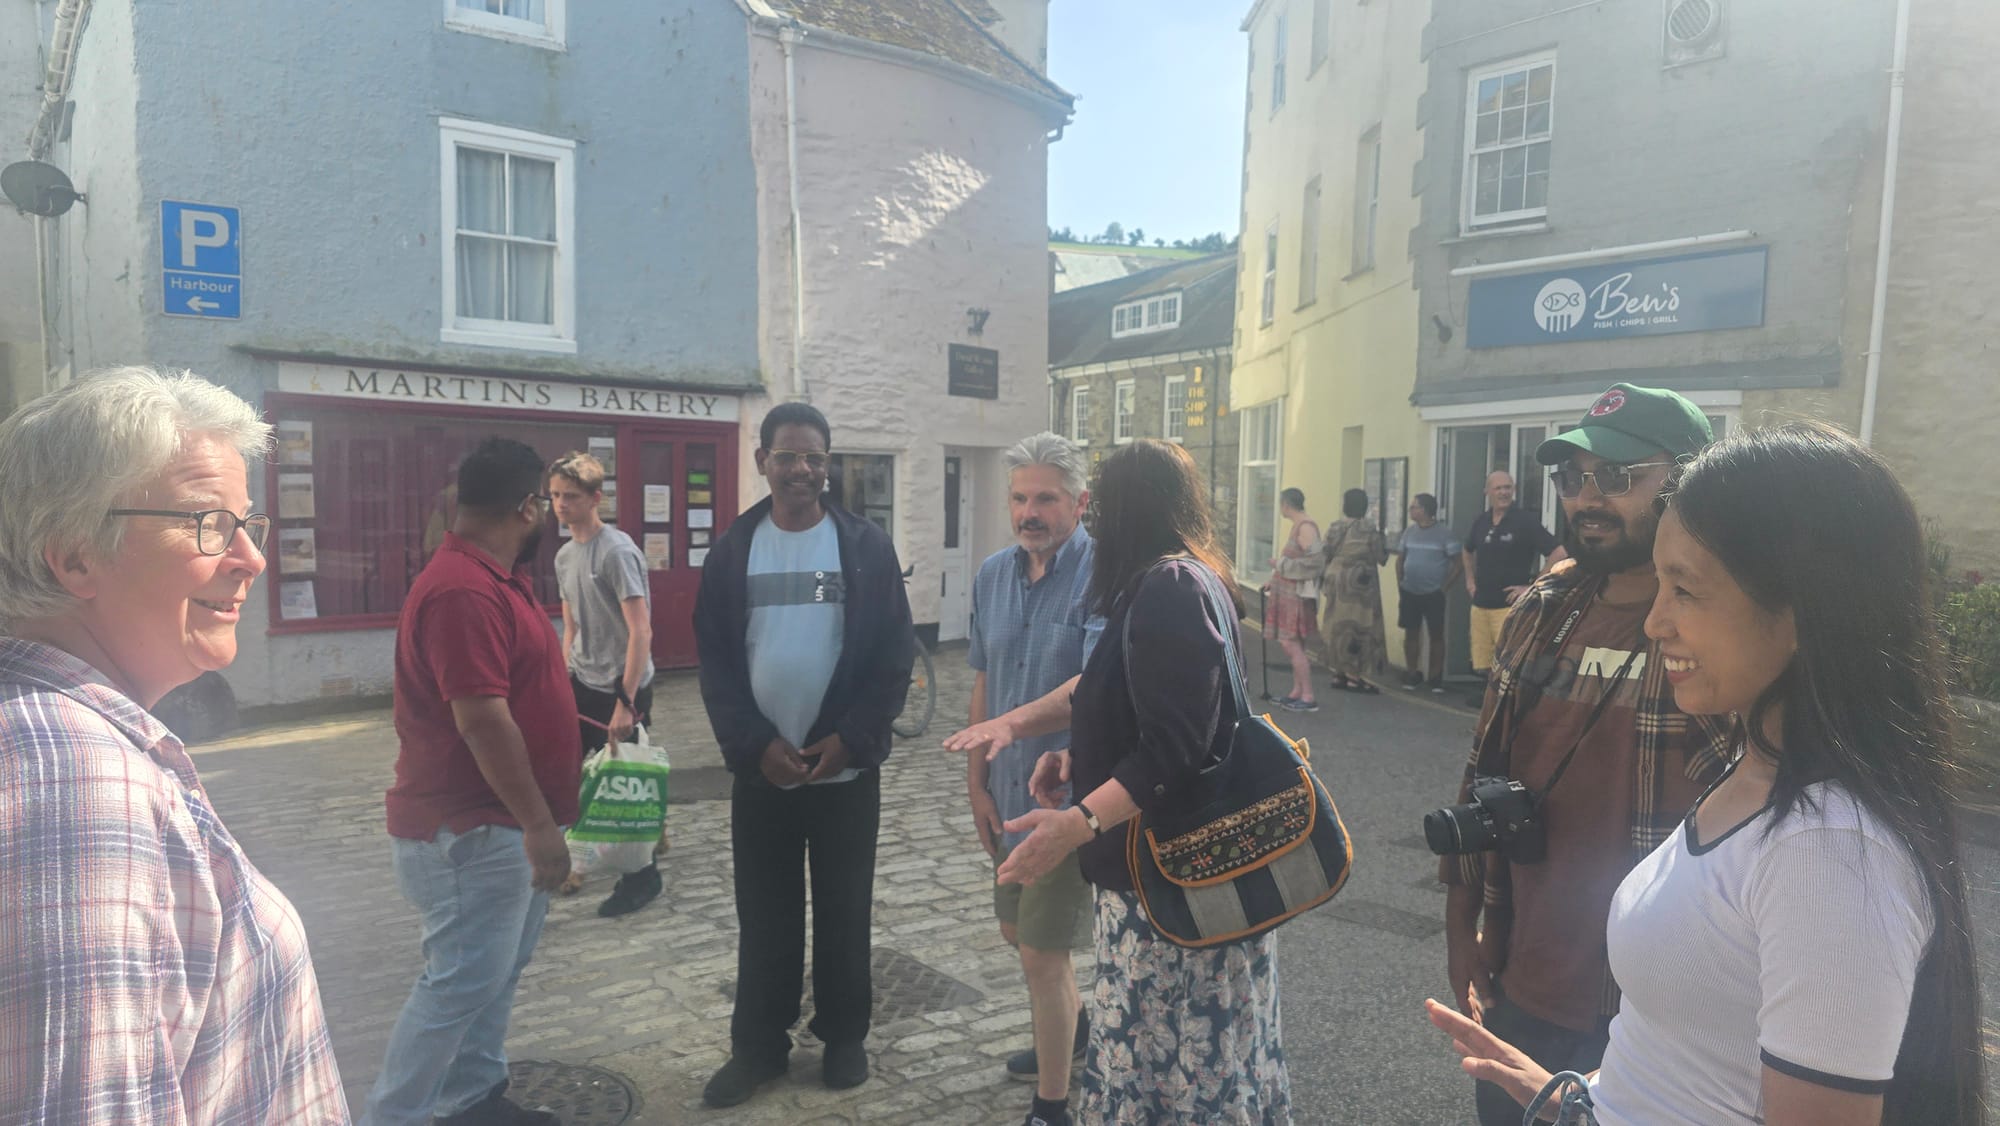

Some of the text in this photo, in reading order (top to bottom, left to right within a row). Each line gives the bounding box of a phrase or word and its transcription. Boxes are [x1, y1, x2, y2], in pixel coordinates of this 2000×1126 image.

[180, 208, 229, 267] P
[171, 277, 234, 293] Harbour
[1589, 272, 1680, 319] Ben's
[1593, 314, 1678, 329] FISH CHIPS GRILL
[344, 370, 719, 416] MARTINS BAKERY
[1188, 387, 1206, 398] THE
[1185, 401, 1207, 413] SHIP
[1187, 415, 1204, 427] INN
[1553, 610, 1580, 643] Canon
[593, 775, 660, 801] ASDA
